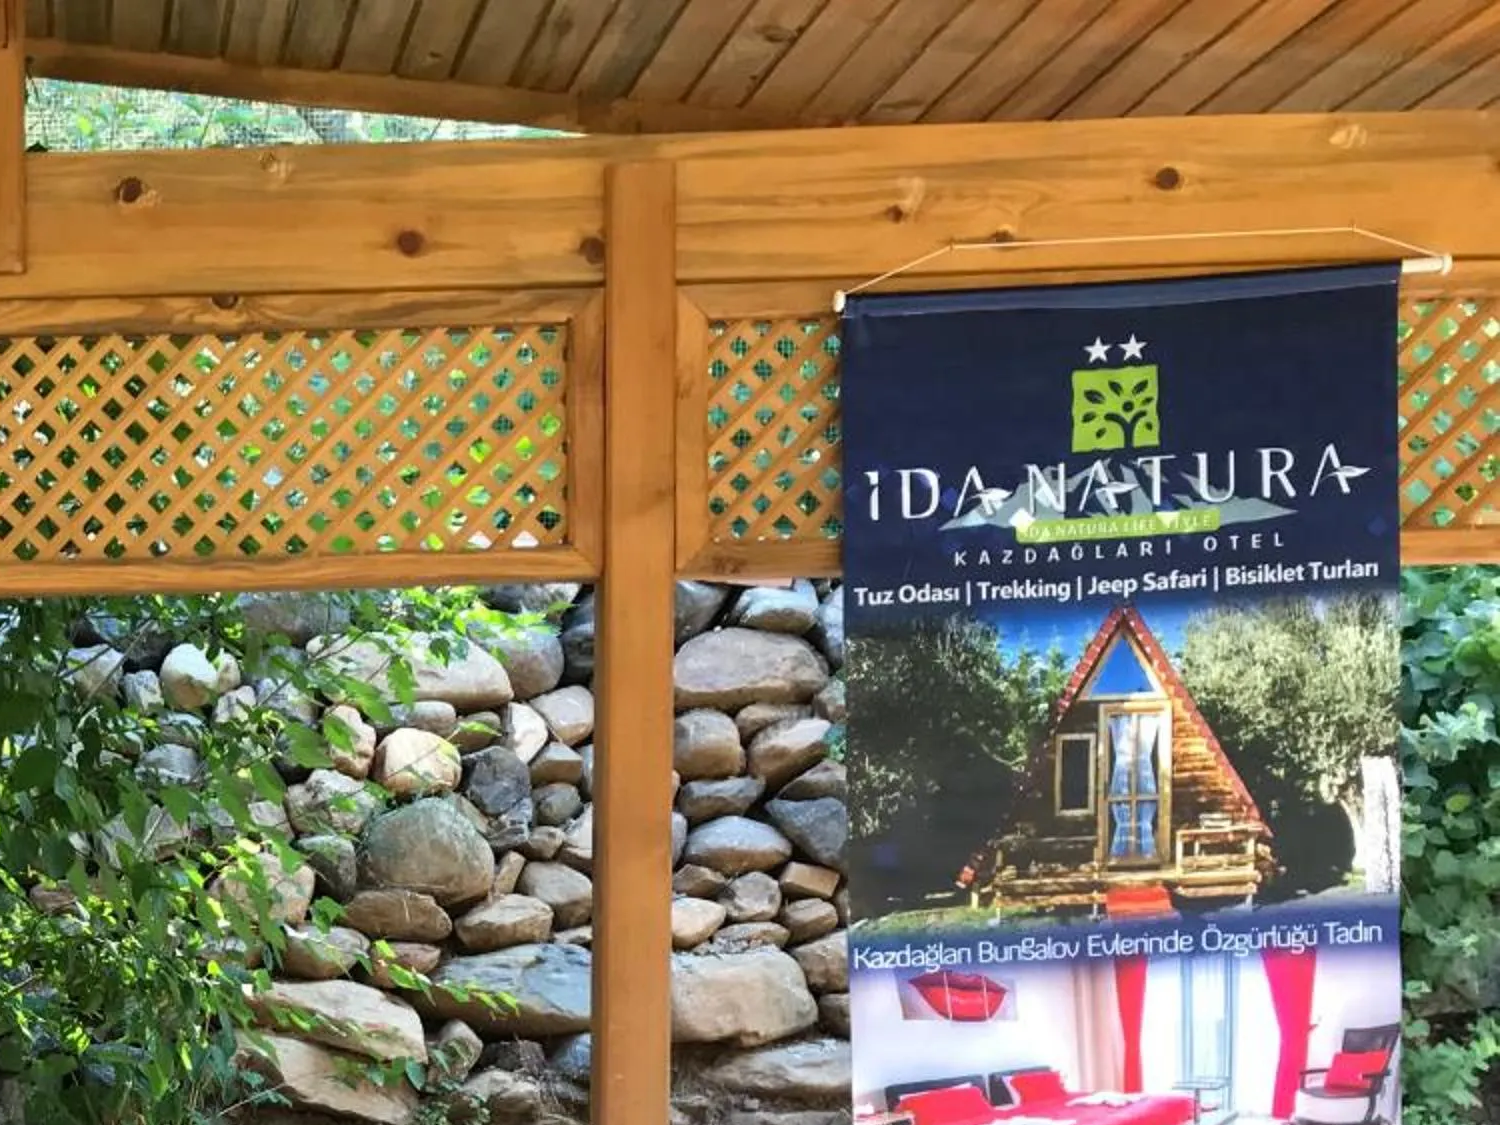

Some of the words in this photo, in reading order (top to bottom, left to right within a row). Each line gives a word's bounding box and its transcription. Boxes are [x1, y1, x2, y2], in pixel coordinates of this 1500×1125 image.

[1023, 443, 1372, 514] NATURA
[954, 539, 1171, 566] KAZDAĞLARI
[1203, 532, 1285, 551] OTEL
[854, 587, 894, 606] Tuz
[900, 583, 960, 602] Odası
[977, 579, 1071, 602] Trekking
[1087, 576, 1138, 598] Jeep
[1143, 568, 1207, 592] Safari
[1225, 563, 1305, 585] Bisiklet
[1308, 559, 1379, 580] Turları
[1087, 929, 1194, 958] Evlerinde
[1202, 923, 1318, 956] Özgürlüğü
[1324, 919, 1383, 945] Tadın
